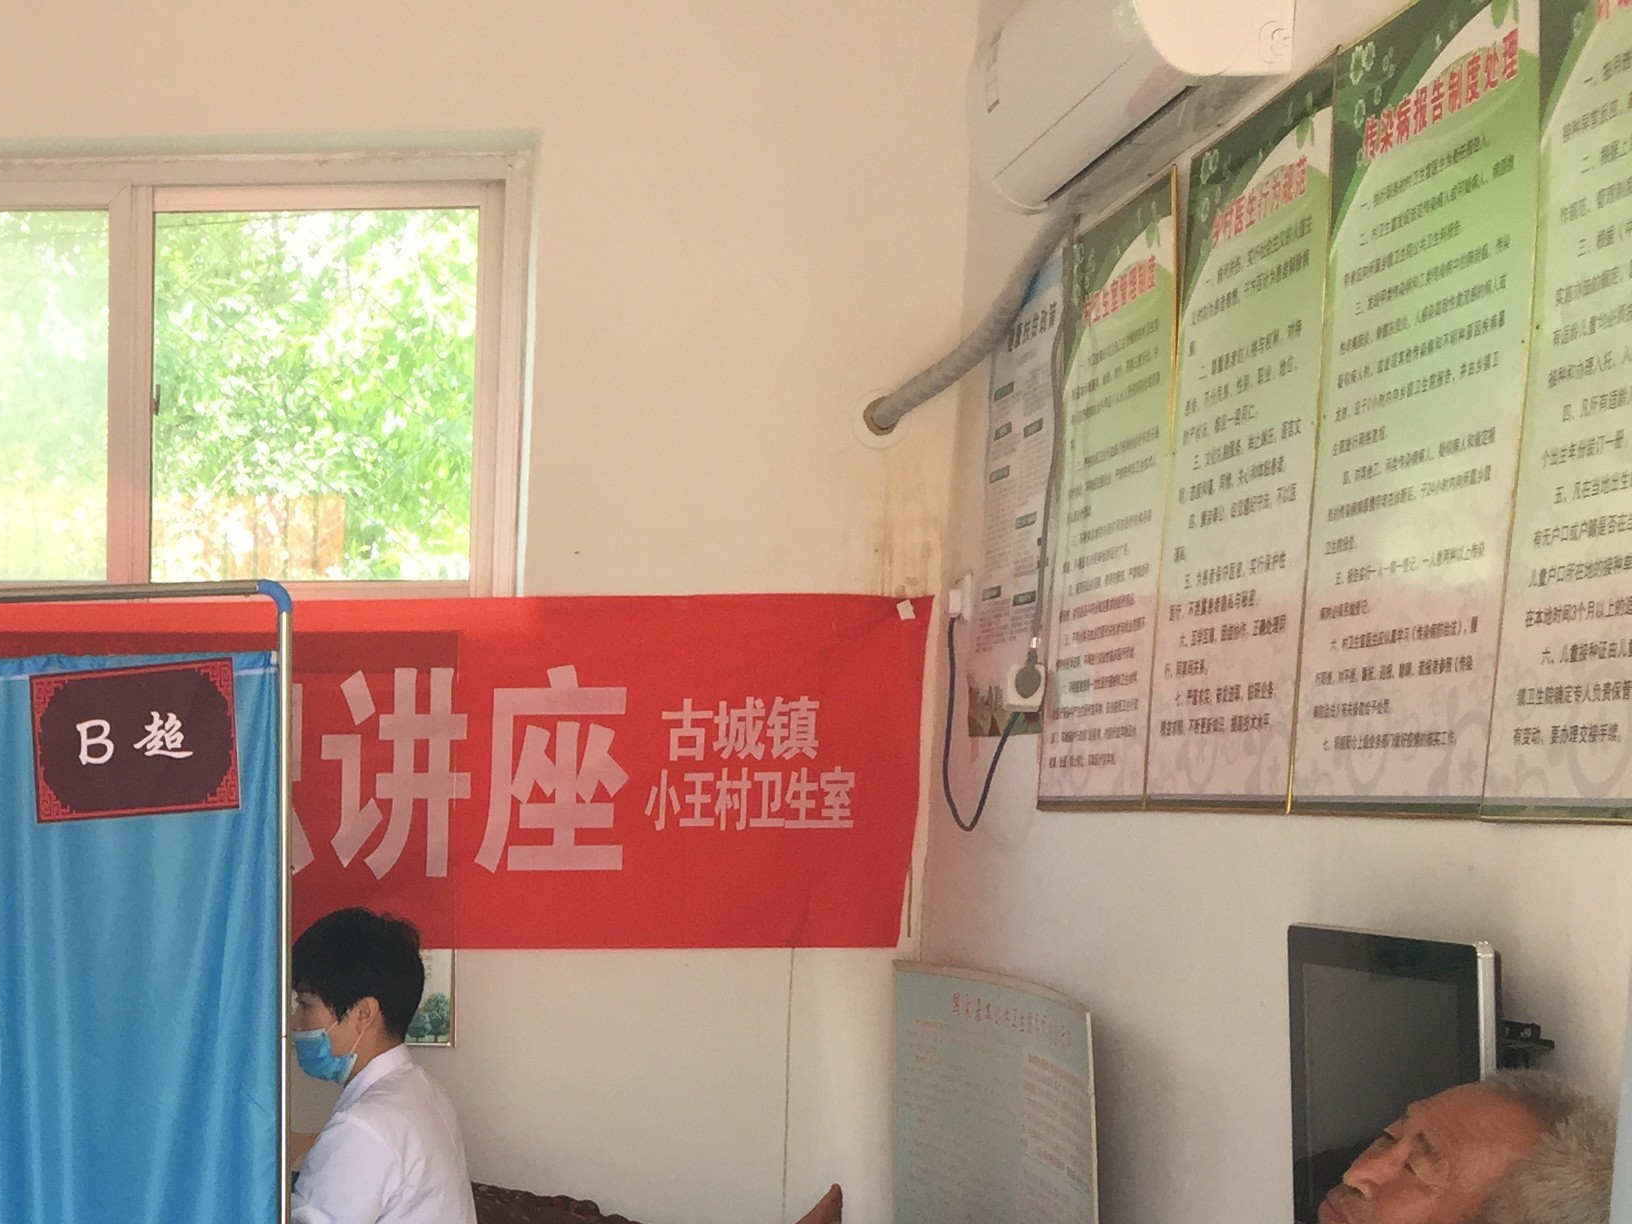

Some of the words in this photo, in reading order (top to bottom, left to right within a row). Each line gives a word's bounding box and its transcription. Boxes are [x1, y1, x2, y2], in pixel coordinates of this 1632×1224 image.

[1363, 29, 1519, 160] 传染病报告制度处理
[1212, 156, 1308, 247] 乡村医生行为规范
[1554, 472, 1632, 504] 五、凡在当地出生
[660, 694, 821, 762] 古城镇
[292, 664, 630, 880] 讲座
[643, 766, 856, 832] 小王村卫生室
